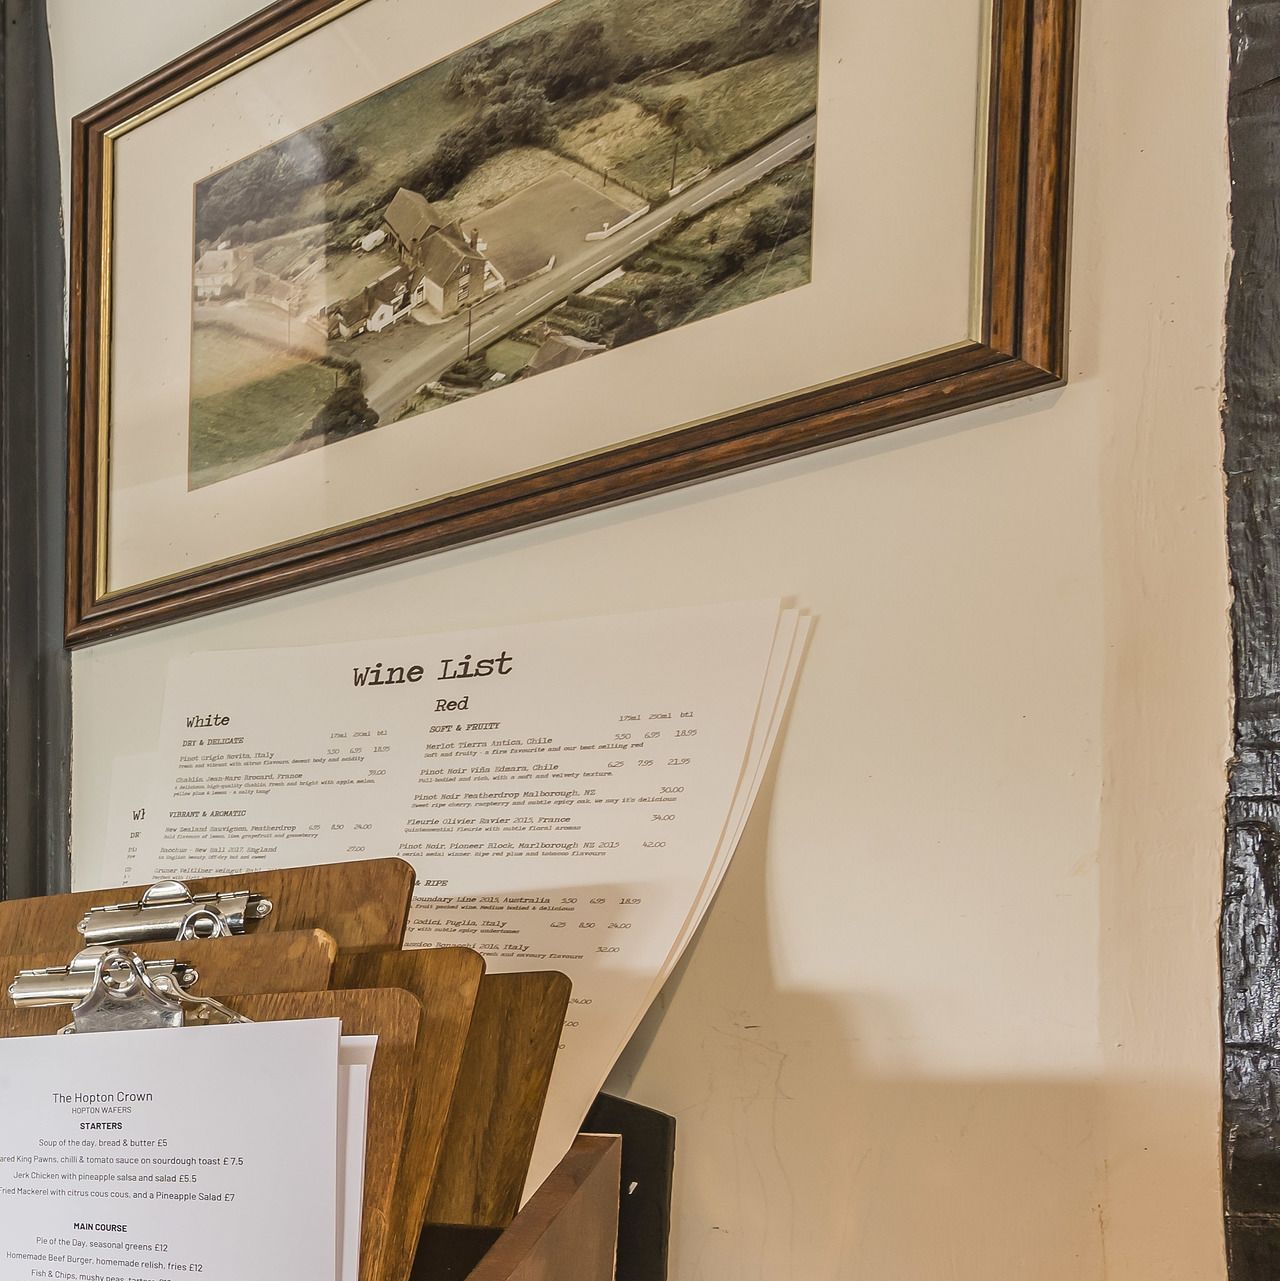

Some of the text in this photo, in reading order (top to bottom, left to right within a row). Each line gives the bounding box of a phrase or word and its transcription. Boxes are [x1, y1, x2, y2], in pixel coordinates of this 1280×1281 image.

[353, 651, 512, 686] Wine List
[434, 696, 469, 712] Red
[186, 713, 230, 728] White
[429, 722, 500, 733] SOFT & FRUITY
[182, 738, 197, 747] DRY
[207, 737, 244, 746] DELICATE
[526, 736, 552, 745] Chile
[168, 810, 200, 818] VIBRANT
[202, 810, 207, 818] &
[53, 1092, 153, 1105] The Hopton Crown
[80, 1122, 123, 1130] STARTERS
[39, 1139, 168, 1149] Soup of the day, bread & butter £5
[17, 1155, 32, 1165] King
[34, 1155, 59, 1165] Pawns,
[61, 1156, 77, 1164] chilli
[79, 1156, 85, 1164] &
[87, 1156, 114, 1164] tomato
[153, 1157, 197, 1167] sourdough
[199, 1157, 221, 1165] toast
[14, 1171, 197, 1183] Jerk Chicken with pineapple salsa and salad £5.5
[17, 1187, 49, 1196] Mackerel
[50, 1188, 66, 1196] with
[67, 1189, 89, 1197] citrus
[111, 1192, 131, 1200] cous,
[133, 1191, 147, 1199] and
[156, 1192, 197, 1202] Pineapple
[199, 1193, 222, 1201] Salad
[224, 1193, 235, 1201] £7
[74, 1222, 128, 1232] MAIN COURSE
[37, 1237, 48, 1245] Pie
[59, 1238, 71, 1246] the
[72, 1239, 88, 1249] Day,
[90, 1241, 123, 1249] seasonal
[125, 1243, 153, 1251] greens
[155, 1243, 168, 1251] £12
[7, 1251, 203, 1272] Homemade Beef Burger, homemade relish, fries £12
[32, 1269, 47, 1278] Fish
[48, 1270, 53, 1278] &
[55, 1271, 78, 1281] Chips,
